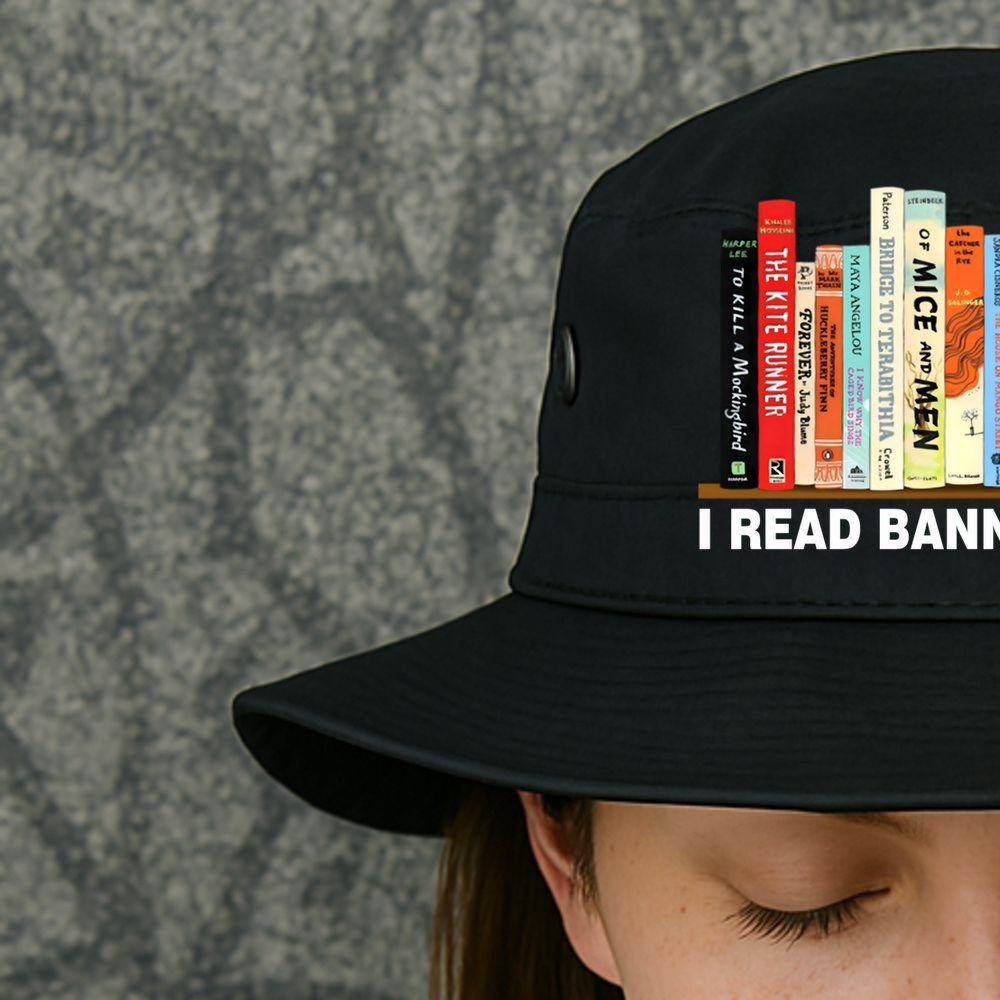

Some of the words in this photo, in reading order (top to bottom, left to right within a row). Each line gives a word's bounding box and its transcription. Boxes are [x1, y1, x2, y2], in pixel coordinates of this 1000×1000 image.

[882, 192, 893, 230] Paterson
[722, 239, 758, 248] HARPER
[919, 228, 930, 252] OF
[956, 229, 970, 237] the
[729, 250, 748, 258] LEE
[765, 247, 789, 282] THE
[850, 254, 861, 292] MAYA
[878, 236, 895, 297] BRIDGE
[732, 266, 745, 287] TO
[912, 258, 938, 333] MICE
[732, 293, 745, 335] KILL
[765, 291, 788, 334] KITE
[850, 295, 862, 357] ANGELOU
[879, 300, 894, 324] TO
[733, 342, 745, 352] A
[798, 308, 813, 380] FOREVER
[819, 305, 829, 380] HUCKLEBERRY
[920, 341, 932, 374] AND
[764, 342, 788, 417] RUNNER
[819, 384, 829, 413] FINN
[855, 375, 863, 404] KNOW
[878, 329, 895, 442] TERABITHIA
[724, 356, 749, 452] Mockingbird
[797, 389, 811, 415] Judy
[912, 378, 939, 451] MEN
[699, 508, 711, 550] I
[731, 508, 861, 550] READ
